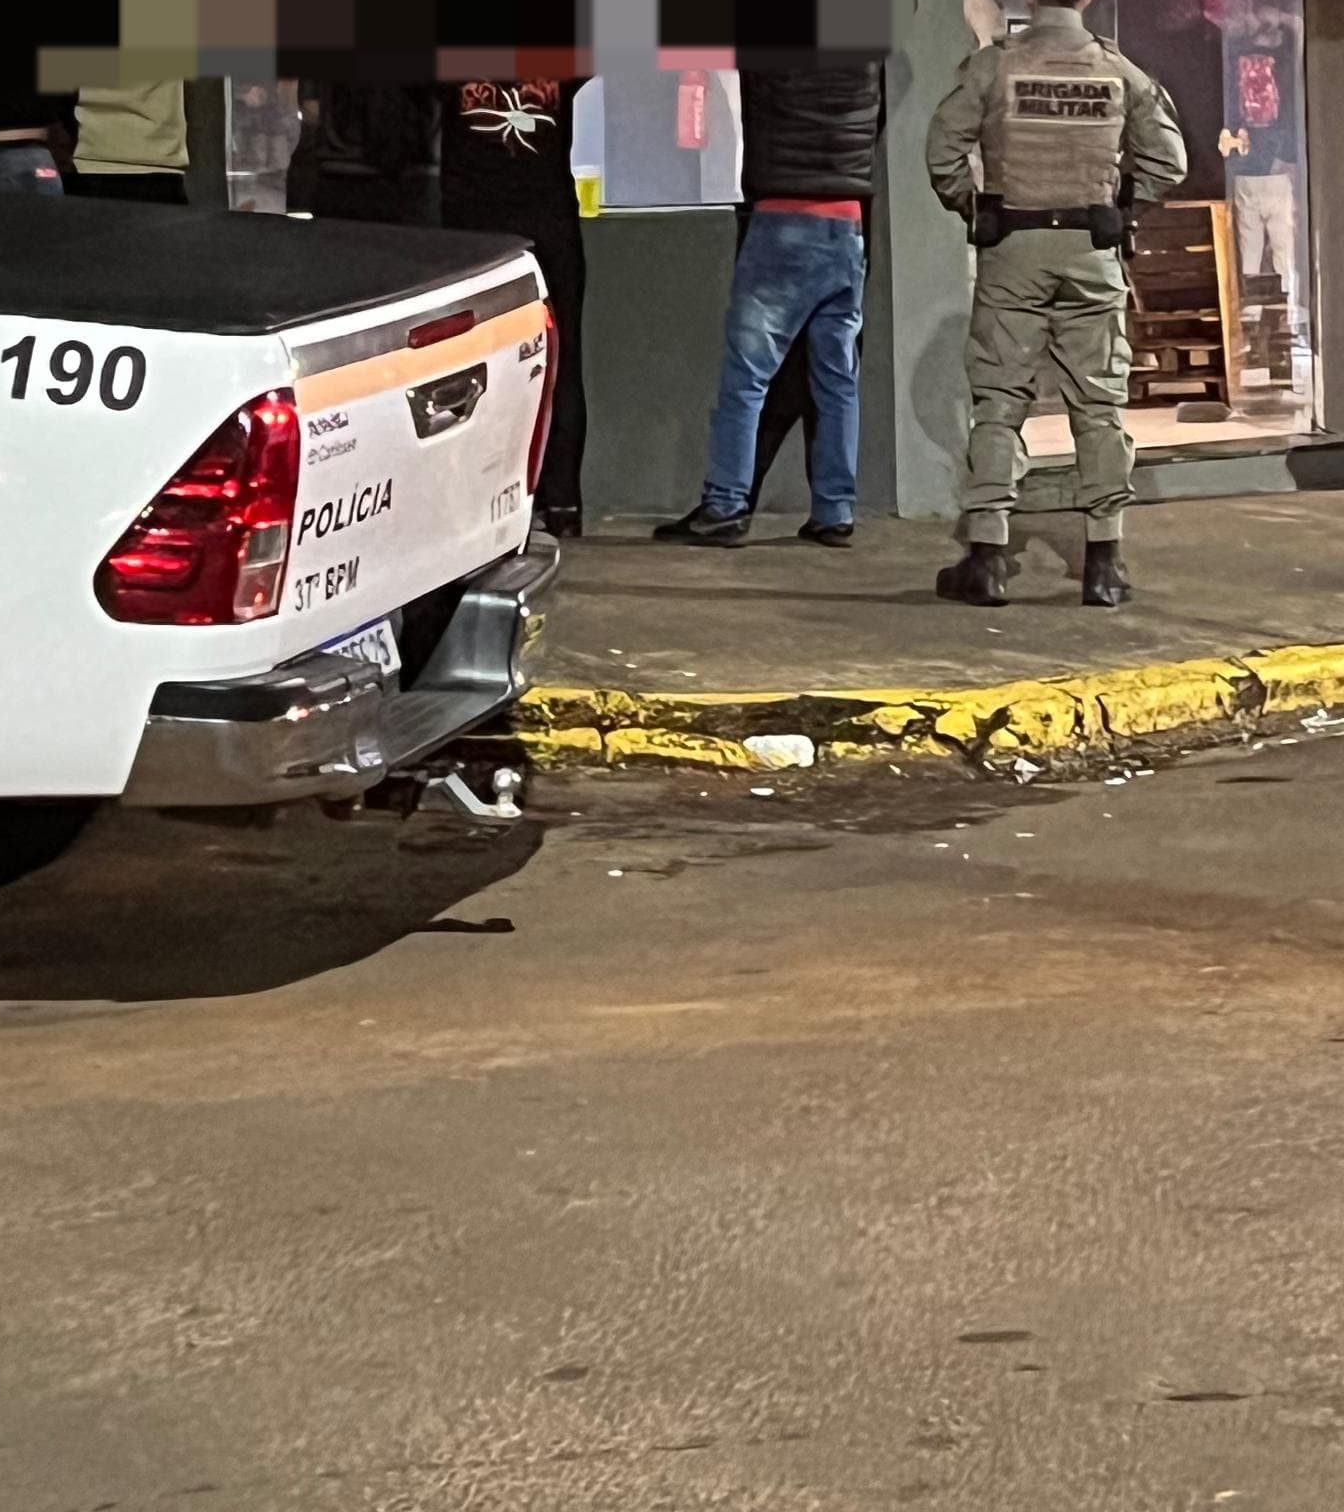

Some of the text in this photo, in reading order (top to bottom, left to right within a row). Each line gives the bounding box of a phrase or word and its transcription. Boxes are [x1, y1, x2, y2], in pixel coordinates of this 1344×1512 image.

[1015, 81, 1112, 100] BRIGADA
[1017, 99, 1107, 118] MILITAR
[0, 335, 147, 411] 190
[325, 556, 359, 600] BPM
